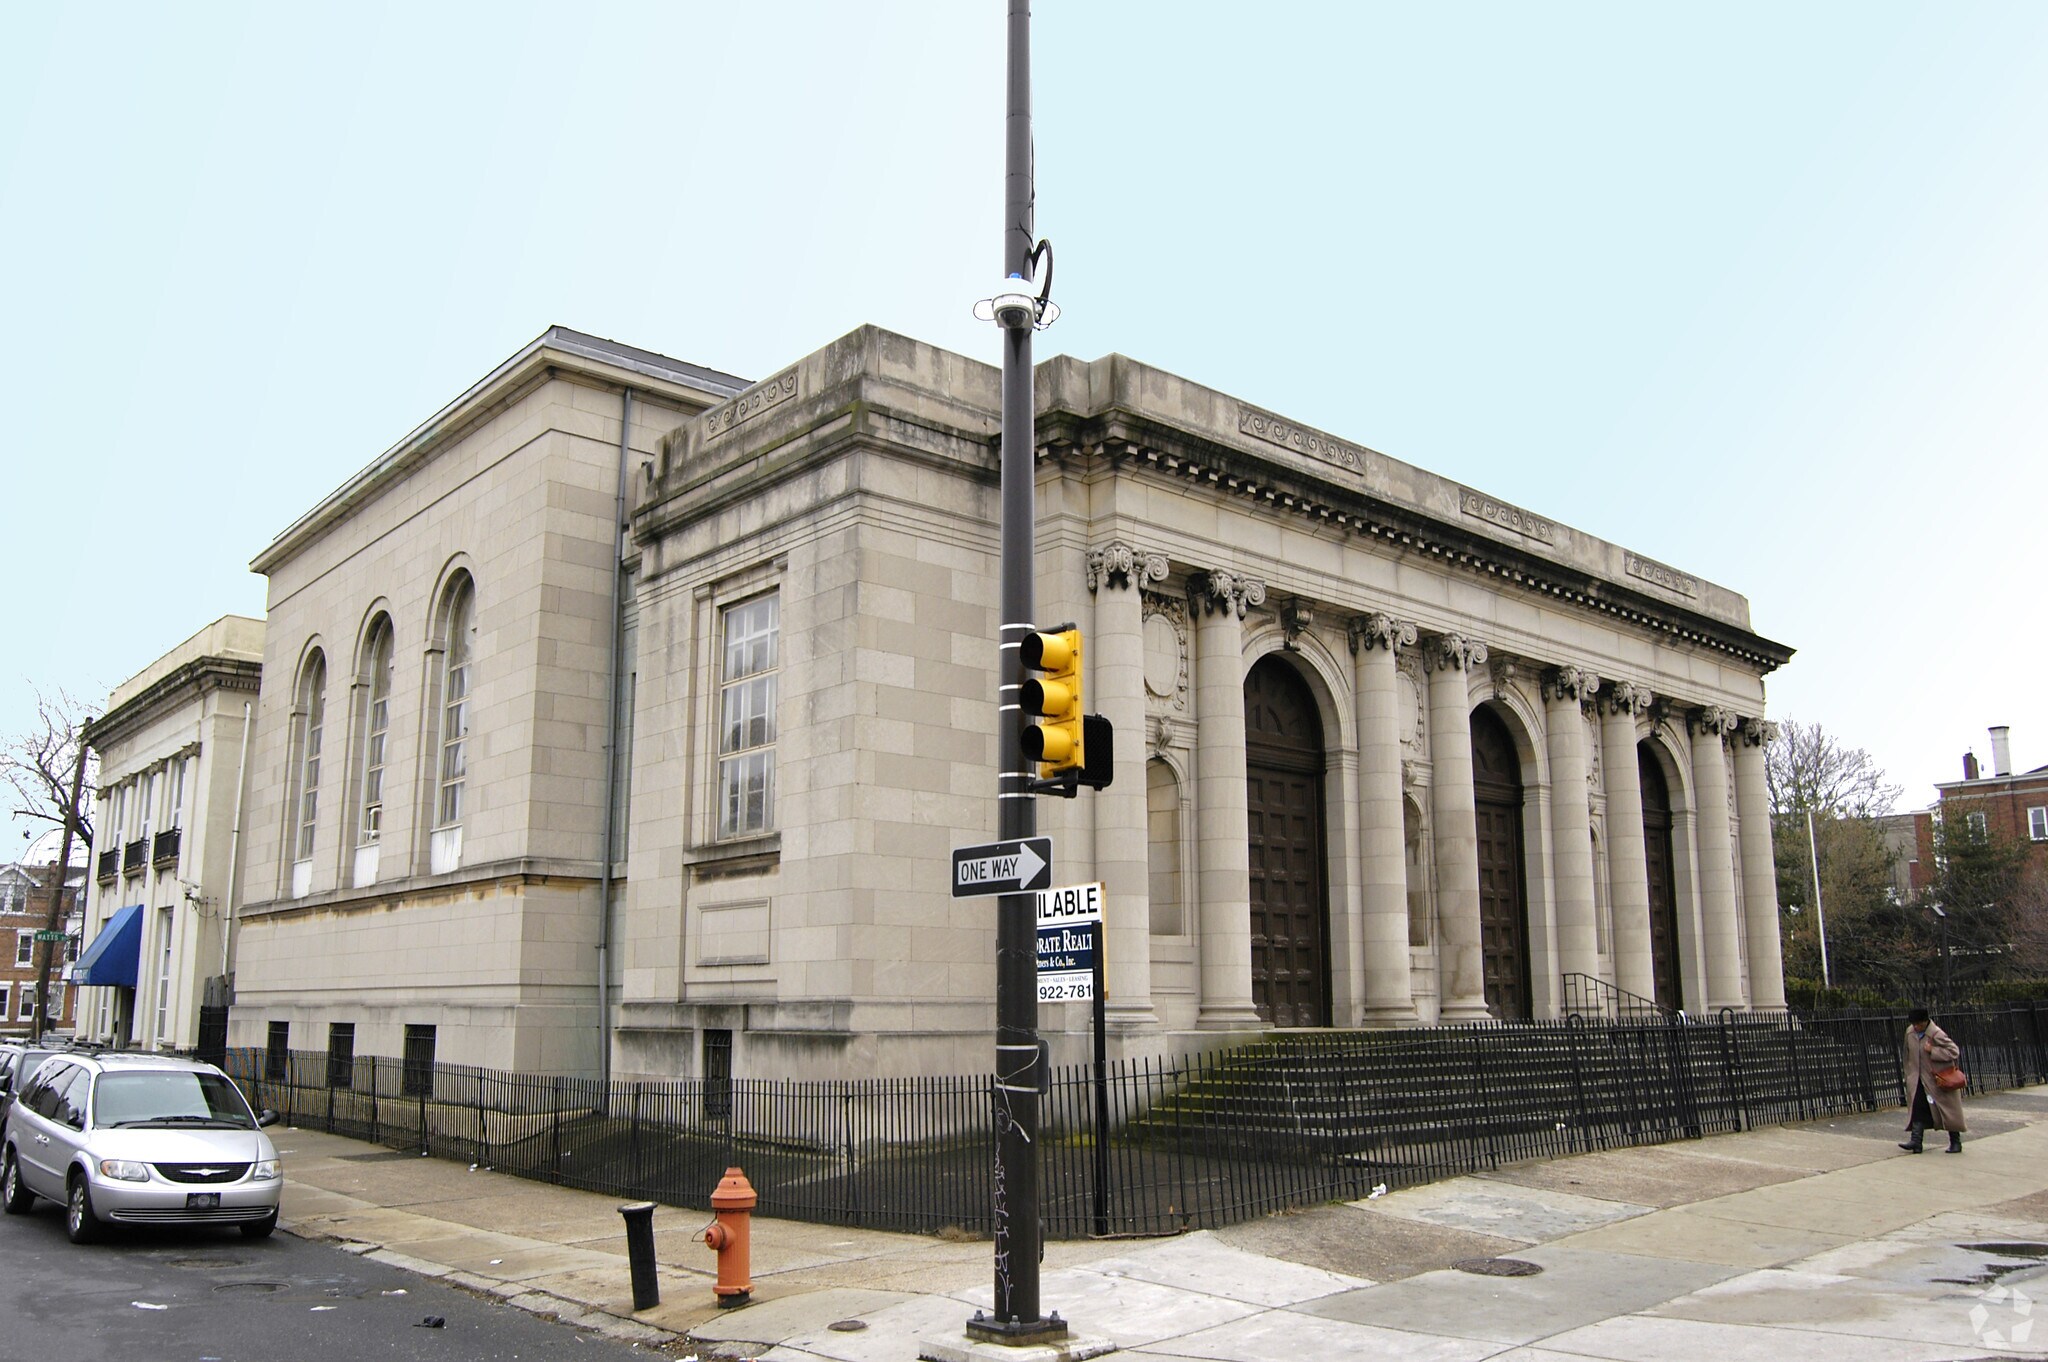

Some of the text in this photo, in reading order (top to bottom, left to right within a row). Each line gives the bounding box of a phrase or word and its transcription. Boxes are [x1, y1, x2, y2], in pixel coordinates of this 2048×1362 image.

[961, 857, 1019, 882] ONE WAY
[1037, 887, 1098, 919] ILABLE
[1036, 936, 1061, 954] RATE
[1049, 956, 1054, 968] &
[1039, 984, 1093, 1000] 922-781
